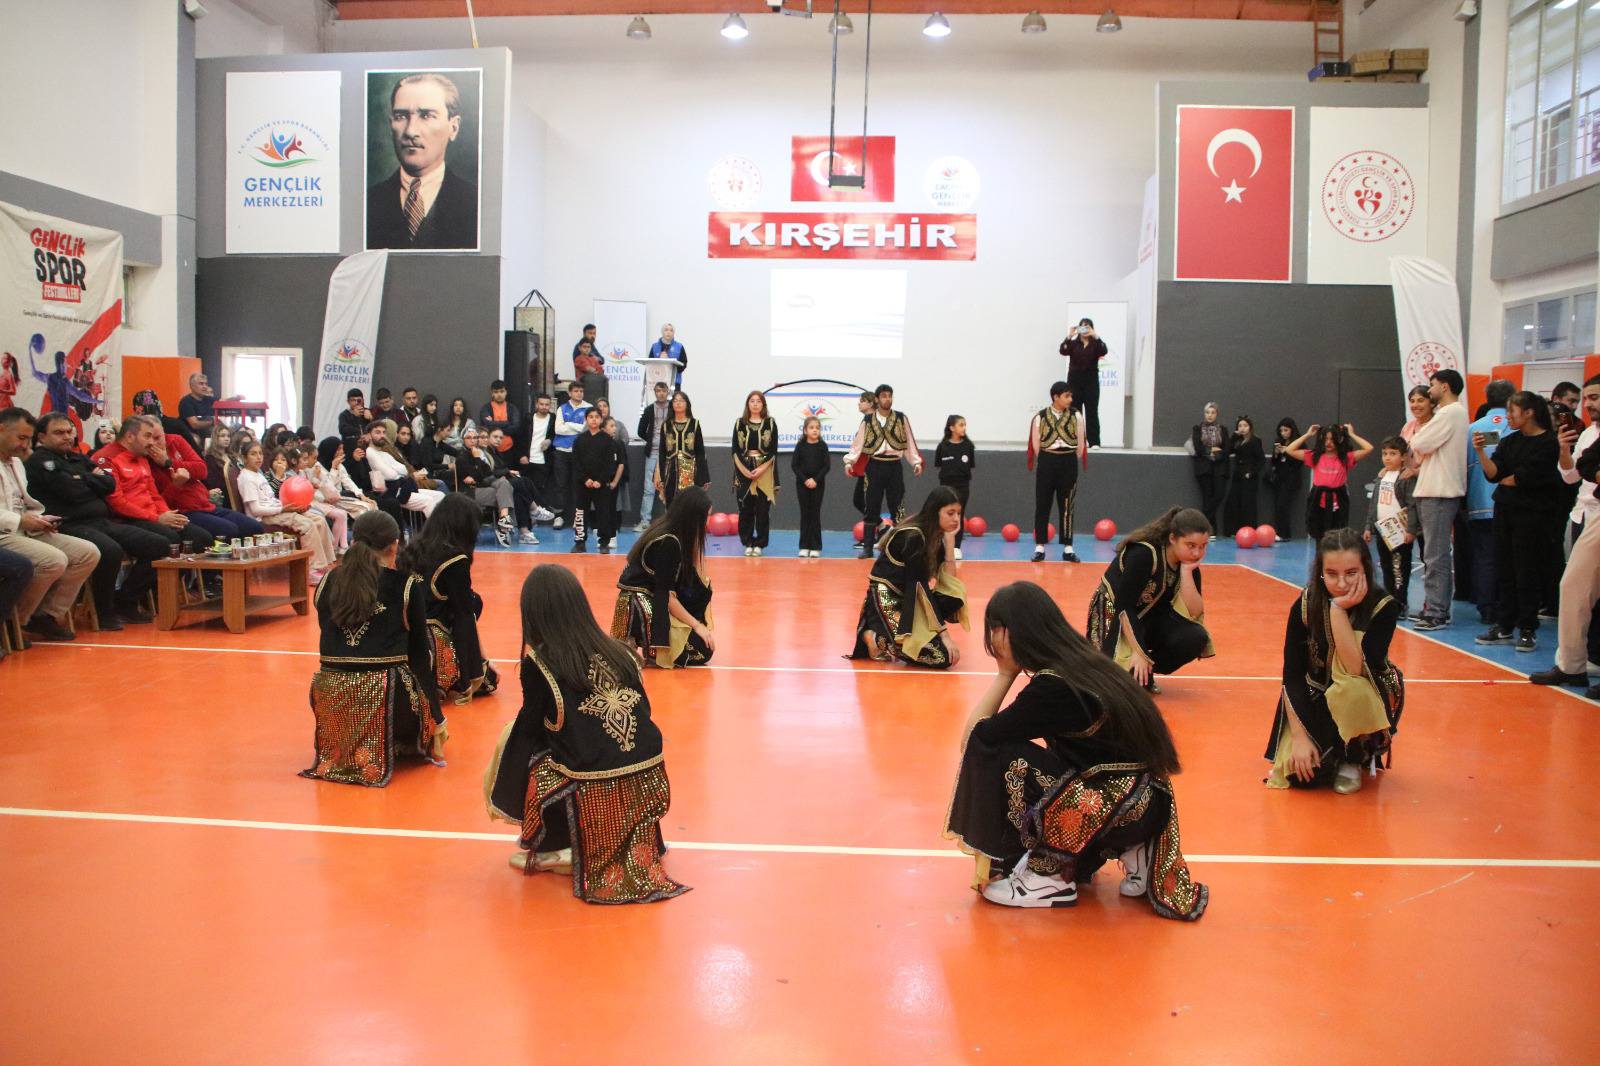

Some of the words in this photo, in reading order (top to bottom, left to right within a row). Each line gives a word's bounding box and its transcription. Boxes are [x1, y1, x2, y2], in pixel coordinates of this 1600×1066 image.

[244, 175, 321, 193] GENÇLİK
[243, 194, 323, 207] MERKEZLERİ
[30, 227, 86, 257] GENÇLİK
[729, 217, 958, 251] KIRŞEHİR
[34, 248, 87, 291] SPOR
